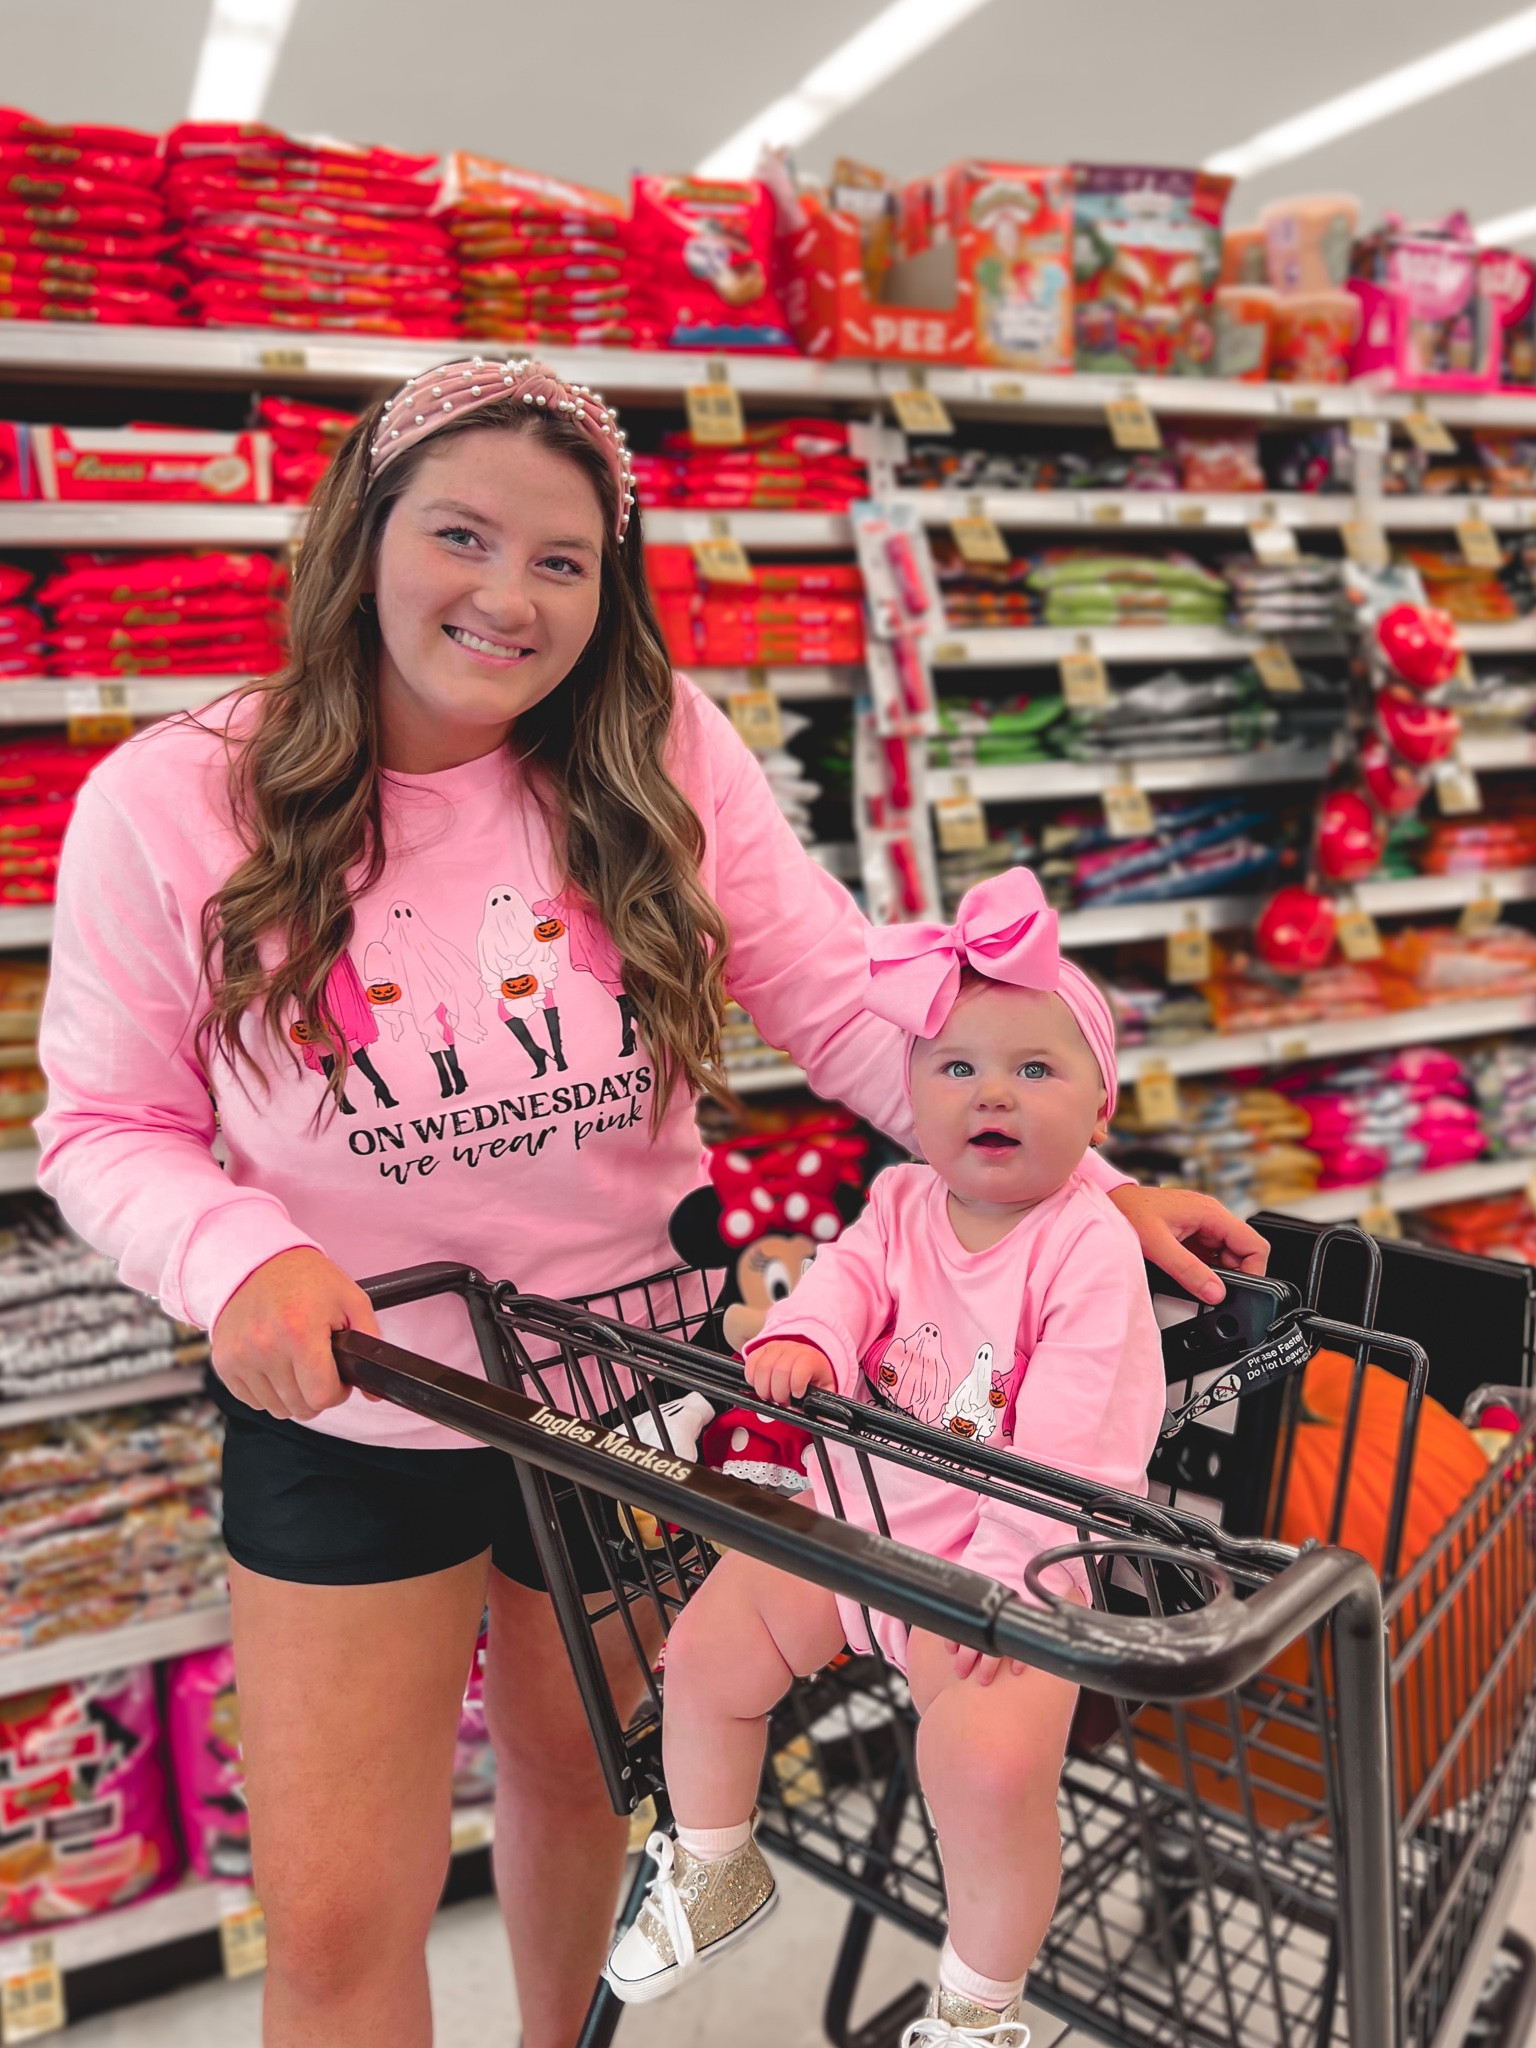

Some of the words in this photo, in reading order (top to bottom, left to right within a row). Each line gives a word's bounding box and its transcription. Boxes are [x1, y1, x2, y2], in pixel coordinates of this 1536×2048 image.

[871, 317, 946, 352] PEZ
[349, 1123, 406, 1156] ON
[410, 1066, 652, 1144] WEDNESDAYS
[380, 1154, 440, 1185] we
[452, 1125, 557, 1167] wear
[574, 1096, 644, 1150] pink
[1246, 1369, 1261, 1381] Do
[1279, 1345, 1305, 1366] Leave
[528, 1405, 596, 1443] Ingles
[594, 1431, 691, 1482] Markets
